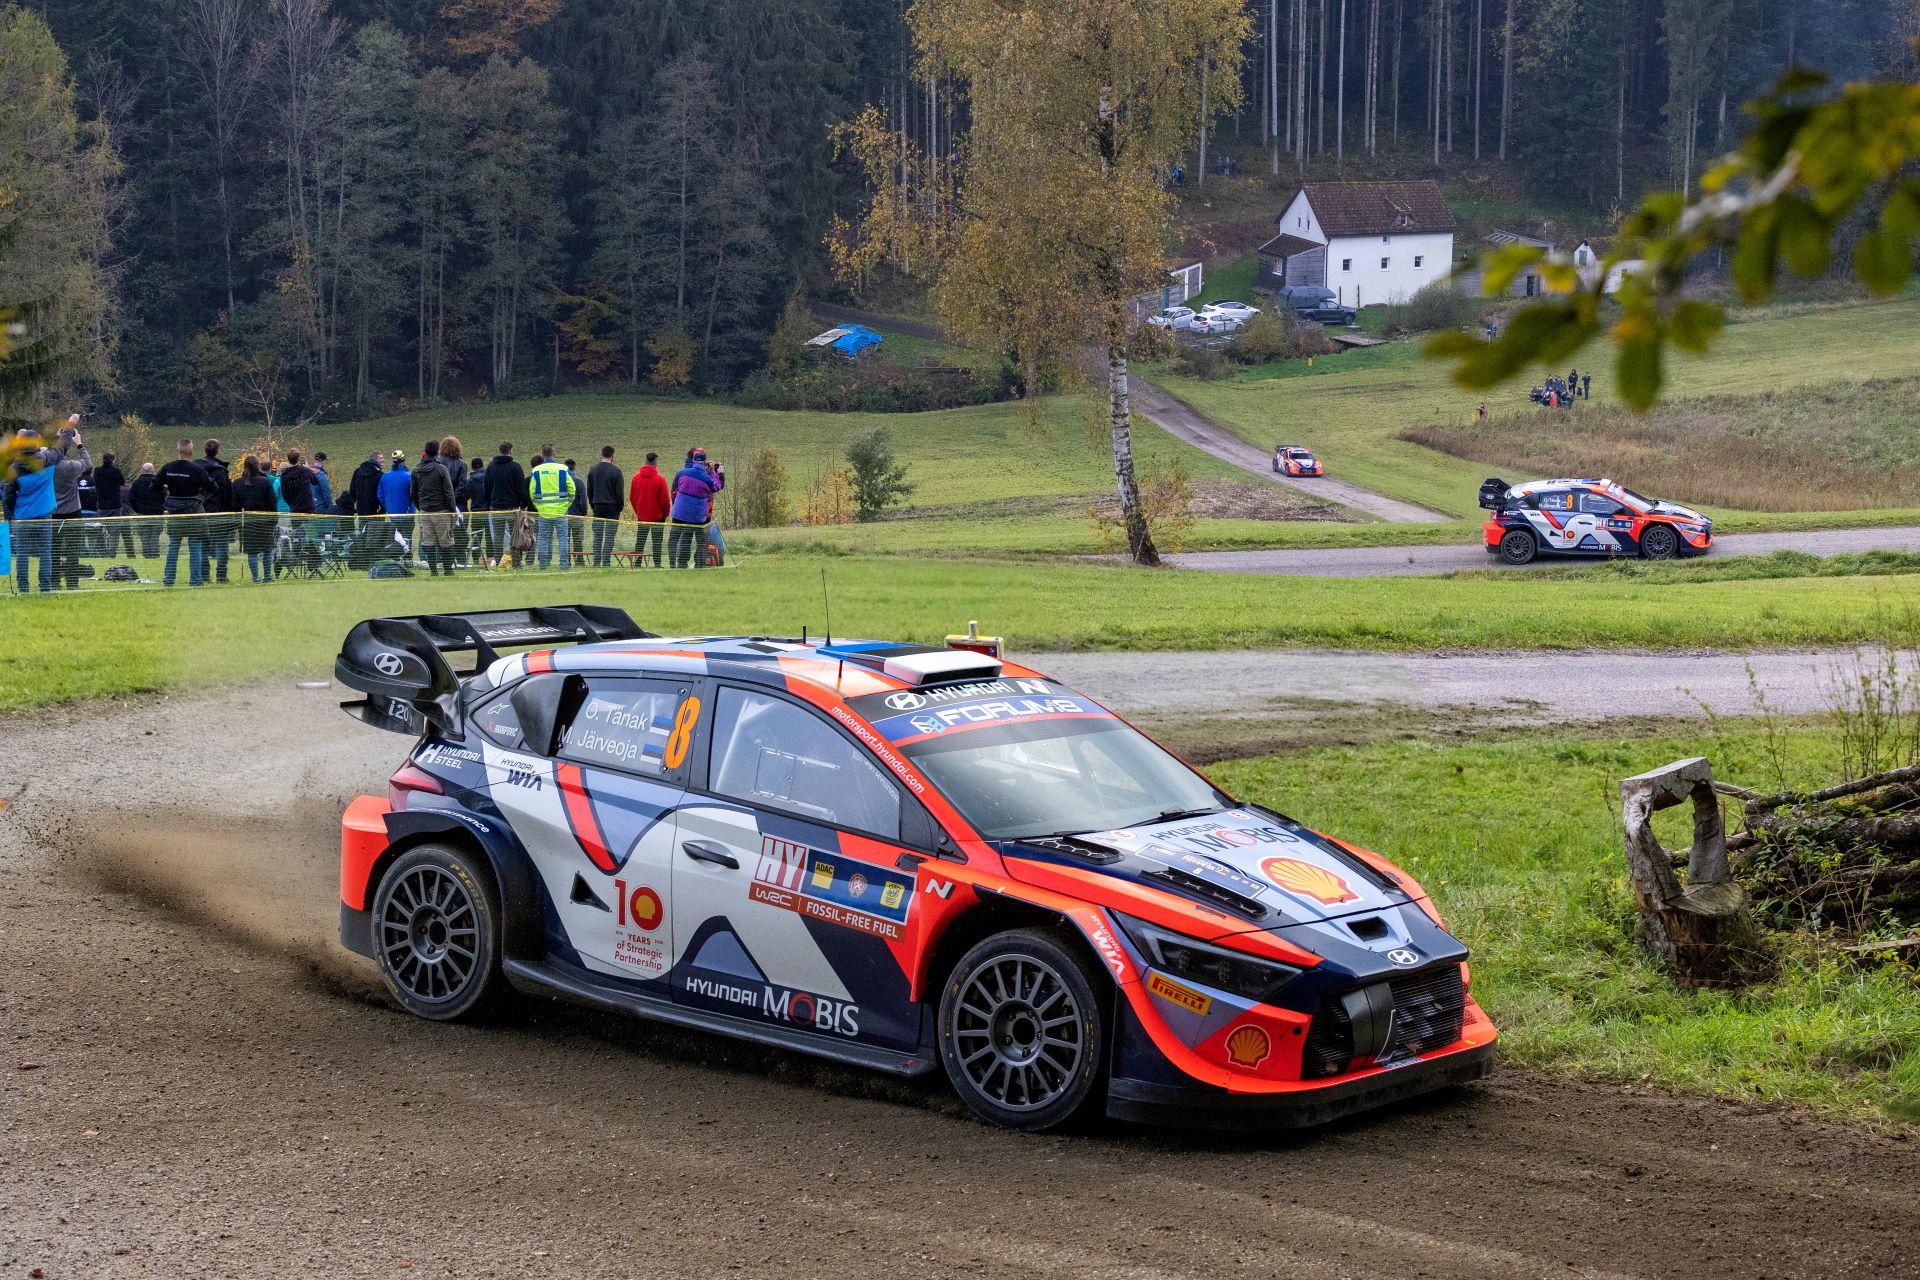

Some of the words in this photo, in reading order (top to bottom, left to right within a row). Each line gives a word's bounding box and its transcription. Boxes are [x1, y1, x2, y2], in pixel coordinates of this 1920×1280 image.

[1566, 493, 1574, 509] 8
[924, 681, 1015, 702] HYUNDAI
[605, 705, 649, 731] Tänak
[935, 699, 1084, 726] FORUM8
[664, 696, 701, 769] 8
[440, 746, 482, 762] HYUNDAI
[577, 728, 638, 761] Järveoja
[831, 705, 926, 794] motorsport.hyundai.com
[434, 755, 462, 769] STEEL
[500, 758, 534, 770] HYUNDAI
[1150, 822, 1228, 841] HYUNDAI
[1184, 827, 1300, 852] MOBIS
[815, 862, 834, 875] ADAC
[613, 877, 664, 932] 10
[755, 889, 793, 907] WRC
[806, 901, 870, 930] FOSSIL-FREE
[872, 920, 899, 939] FUEL
[627, 933, 651, 946] YEARS
[1090, 915, 1122, 952] HYUNDAI
[614, 950, 663, 972] Partnership
[616, 940, 625, 952] of
[626, 942, 663, 960] Strategic
[1152, 976, 1207, 1011] PIRELLI
[686, 976, 758, 1008] HYUNDAI
[763, 986, 861, 1037] MOBIS
